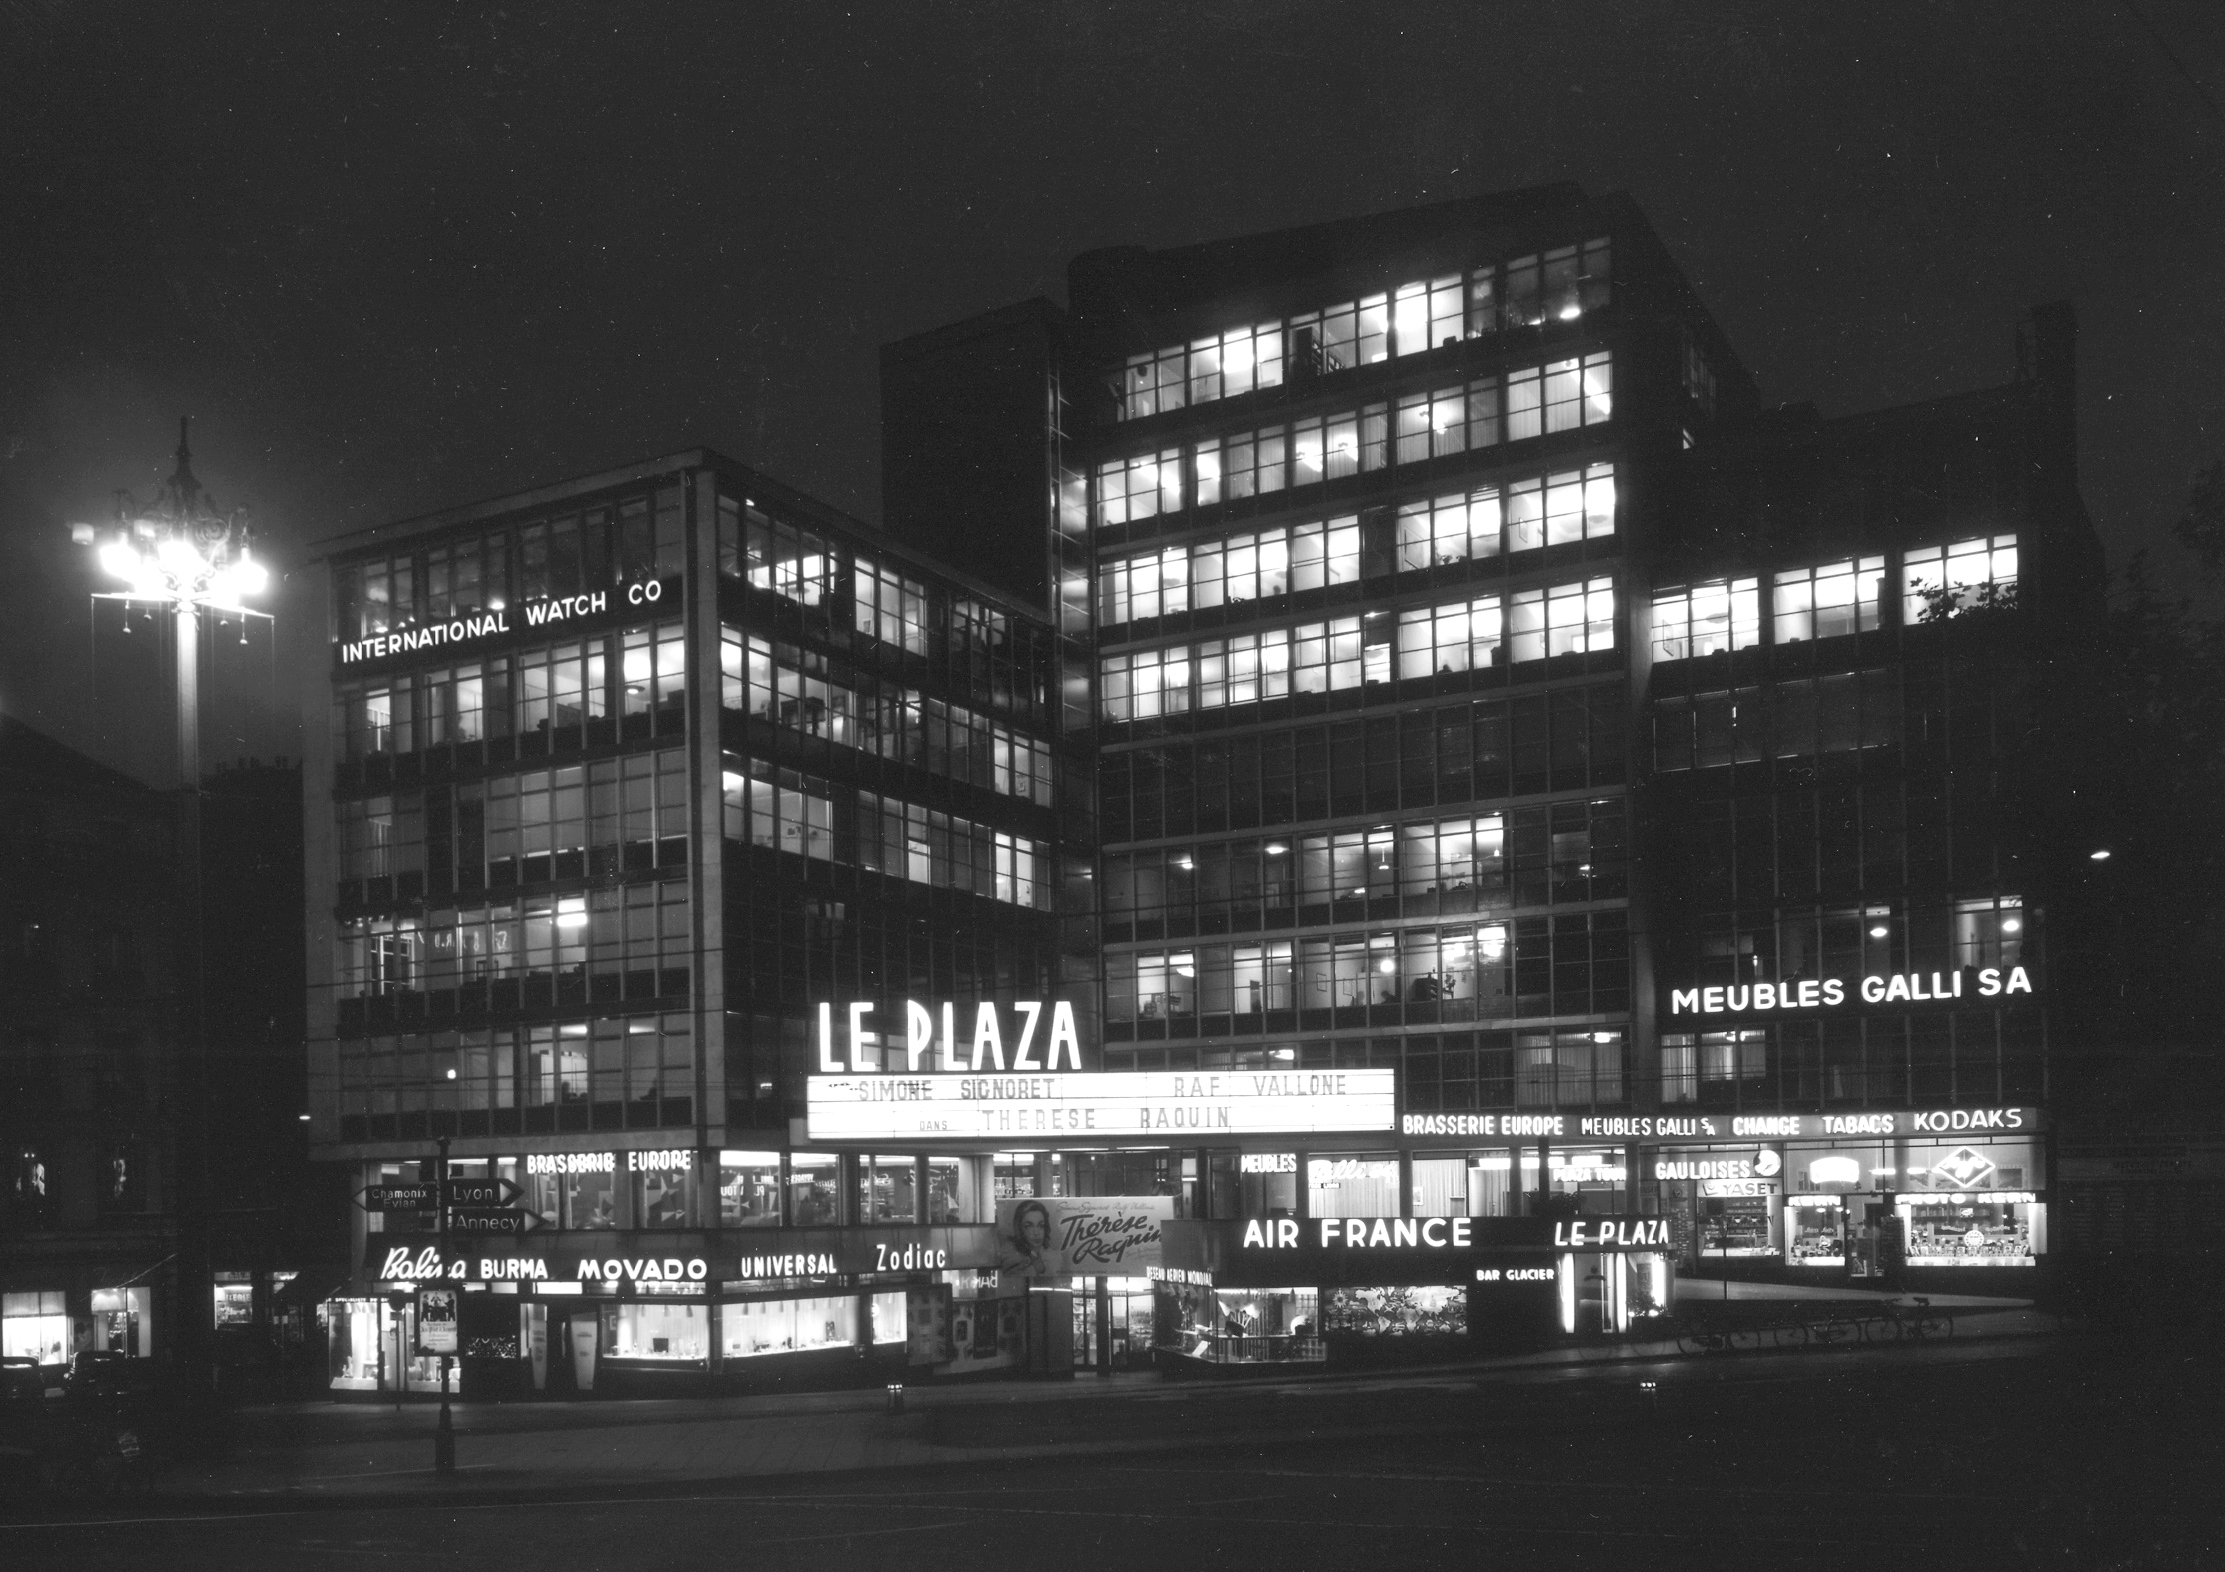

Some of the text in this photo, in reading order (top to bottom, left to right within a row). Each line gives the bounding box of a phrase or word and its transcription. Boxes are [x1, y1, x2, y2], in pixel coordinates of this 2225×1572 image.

[342, 580, 662, 664] INTERNATIONAL WATCH CO
[1671, 966, 2032, 1015] MEUBLES GALLI SA
[819, 1000, 1083, 1072] LE PLAZA
[859, 1075, 1346, 1102] SIMONE SIGNORET RAF VALLONE
[919, 1107, 1229, 1131] DANS THERESE RAQUIN
[1403, 1115, 1563, 1136] BRASSERIE EUROPE
[1582, 1117, 1651, 1136] MEUBLES
[1656, 1118, 1696, 1136] GALLI
[1732, 1116, 1800, 1136] CHANGE
[1822, 1115, 1894, 1134] TABACS
[1914, 1108, 2022, 1131] KODAKS
[628, 1150, 692, 1171] EUROPE
[1241, 1154, 1297, 1173] MEUBLES
[1655, 1160, 1750, 1180] GAULOISES
[371, 1188, 427, 1199] Chamonix
[453, 1185, 493, 1202] Lyon
[1723, 1182, 1778, 1196] YASET
[1895, 1192, 2036, 1205] PHOTO KERN
[383, 1199, 416, 1208] Evian
[457, 1215, 520, 1232] Annecy
[1060, 1211, 1149, 1251] Thérèse
[1243, 1217, 1471, 1248] AIR FRANCE
[1554, 1221, 1587, 1246] LE
[1599, 1220, 1669, 1246] PLAZA
[741, 1253, 837, 1278] UNIVERSAL
[876, 1243, 946, 1271] Zodiac
[481, 1258, 548, 1280] BURMA
[577, 1258, 708, 1281] MOVADO
[1476, 1268, 1555, 1282] BAR GLACIER
